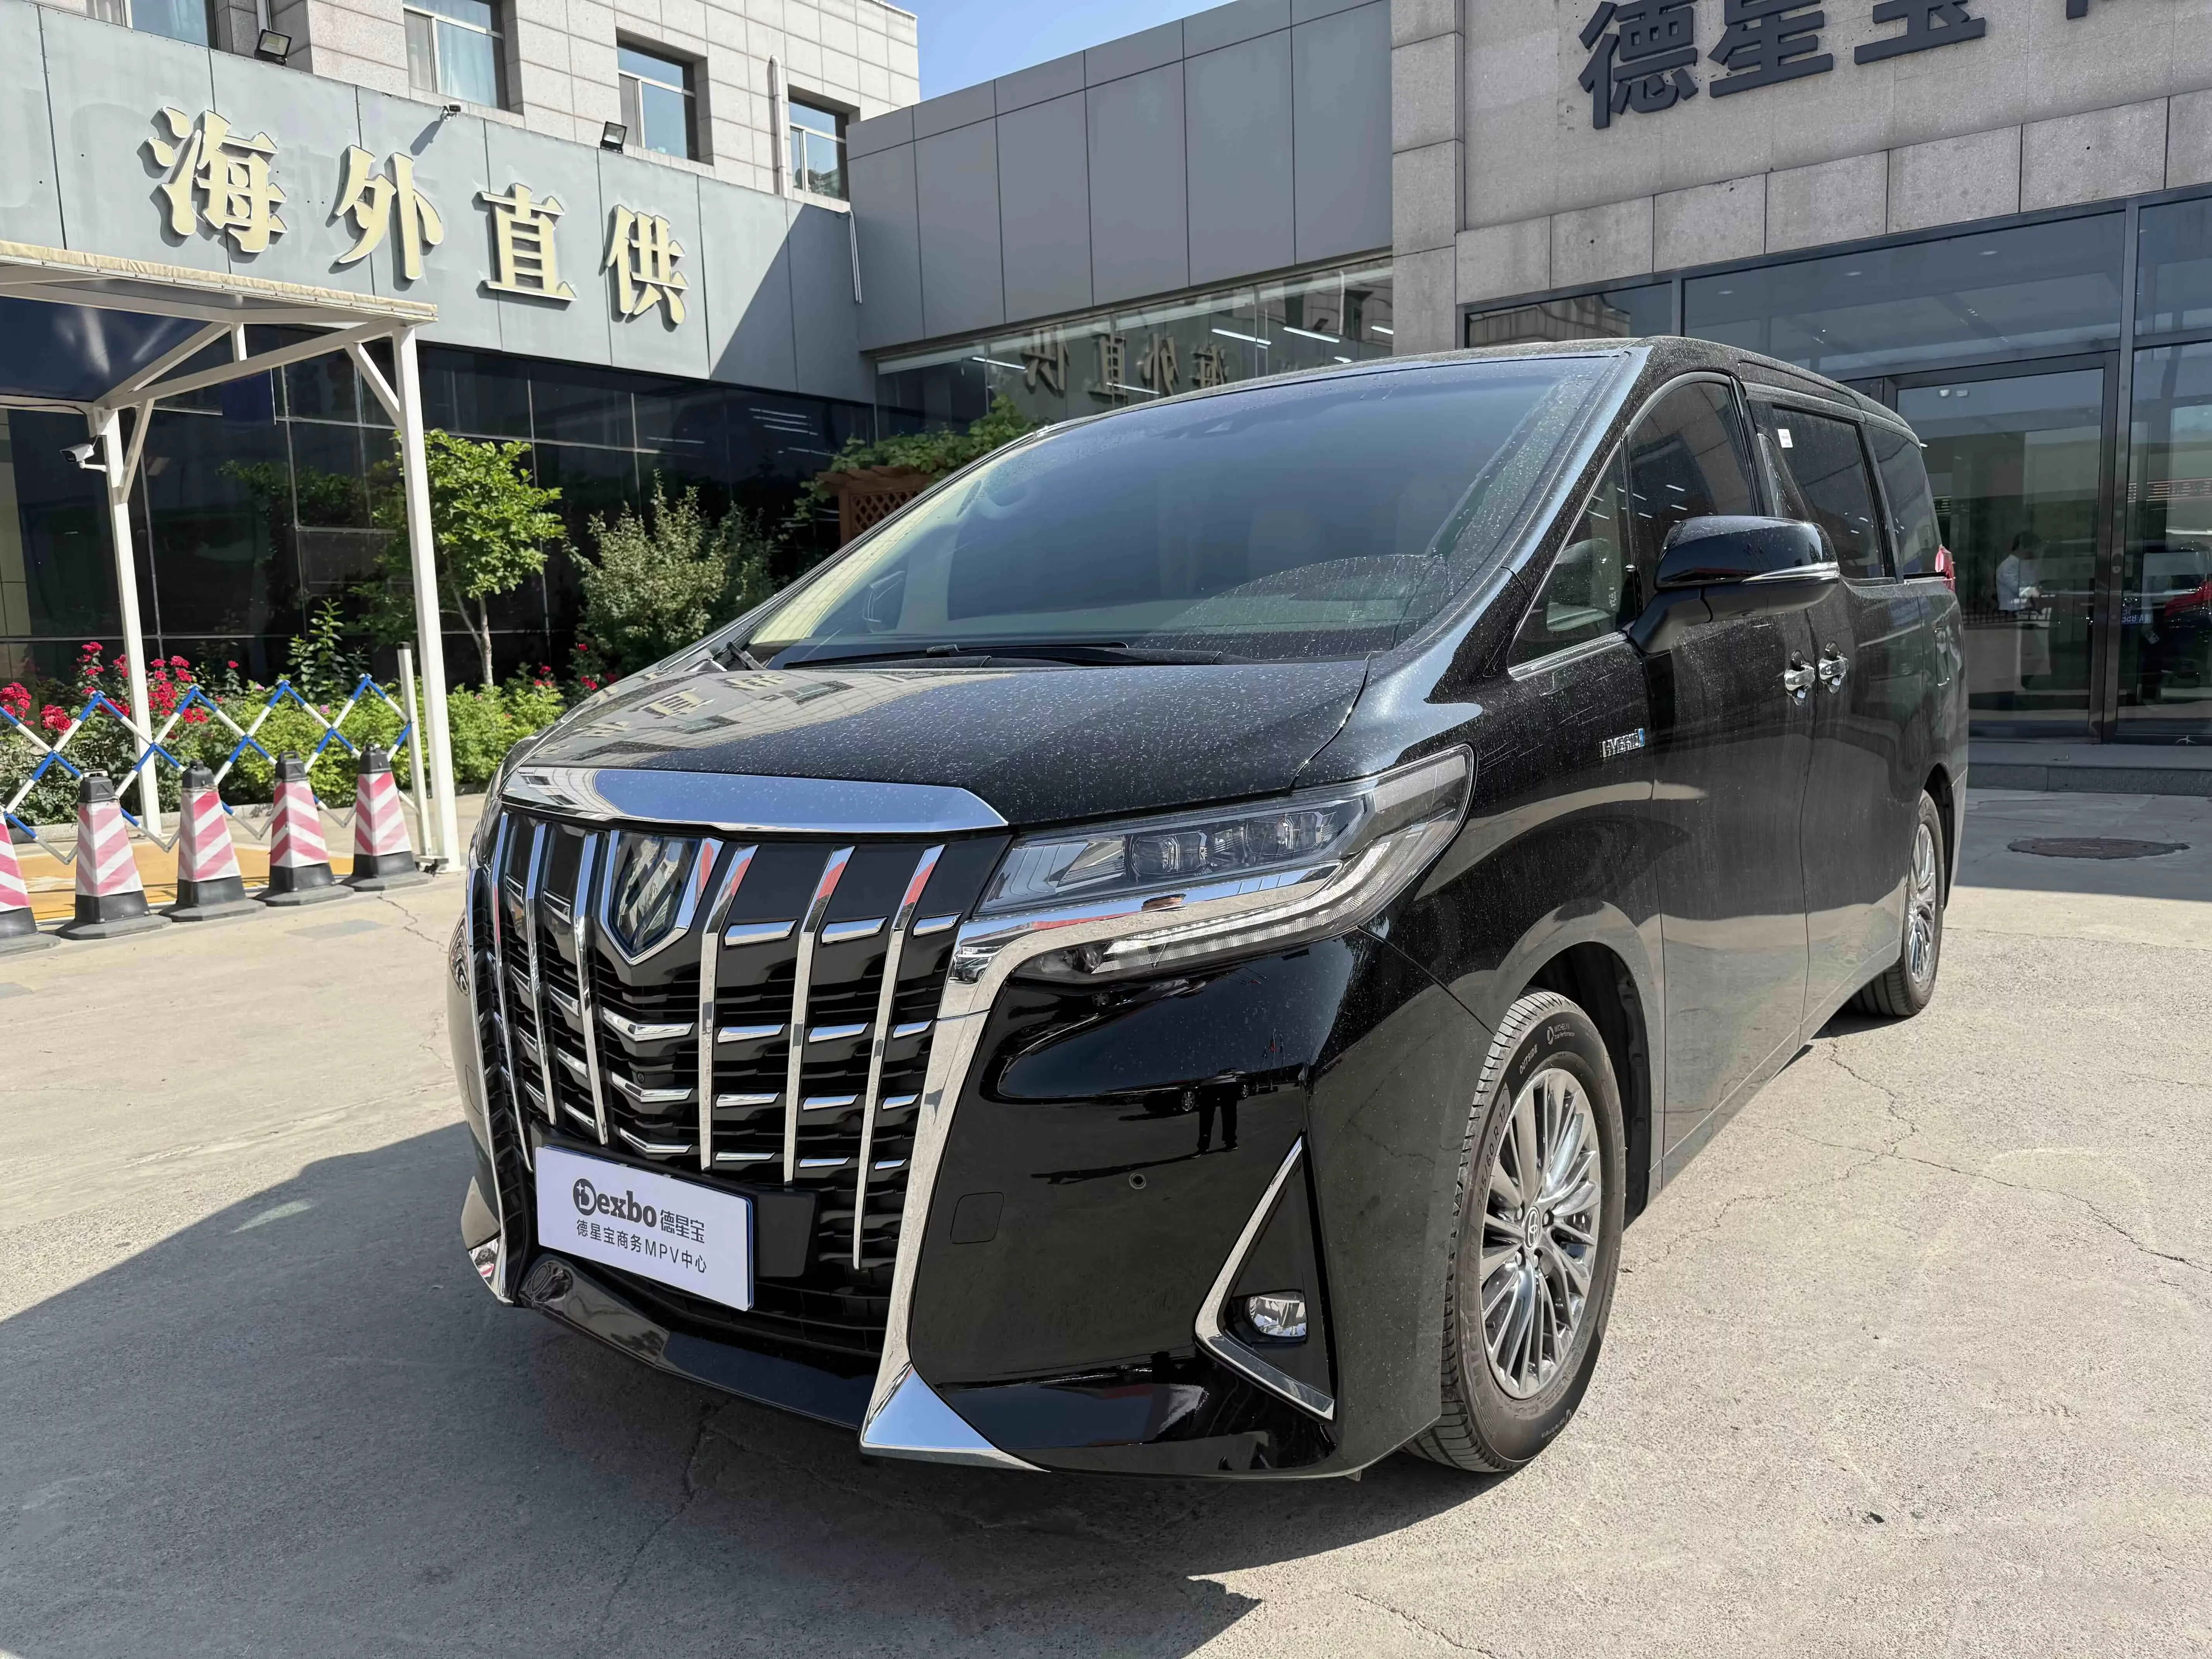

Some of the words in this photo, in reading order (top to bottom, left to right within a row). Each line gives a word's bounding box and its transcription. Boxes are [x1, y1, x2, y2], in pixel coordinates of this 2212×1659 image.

[148, 106, 689, 325] 海外直供
[1519, 1044, 1538, 1075] OUTSIDE
[576, 1219, 707, 1273] 德星宝商务MPV中心
[660, 1209, 705, 1244] 德星宝
